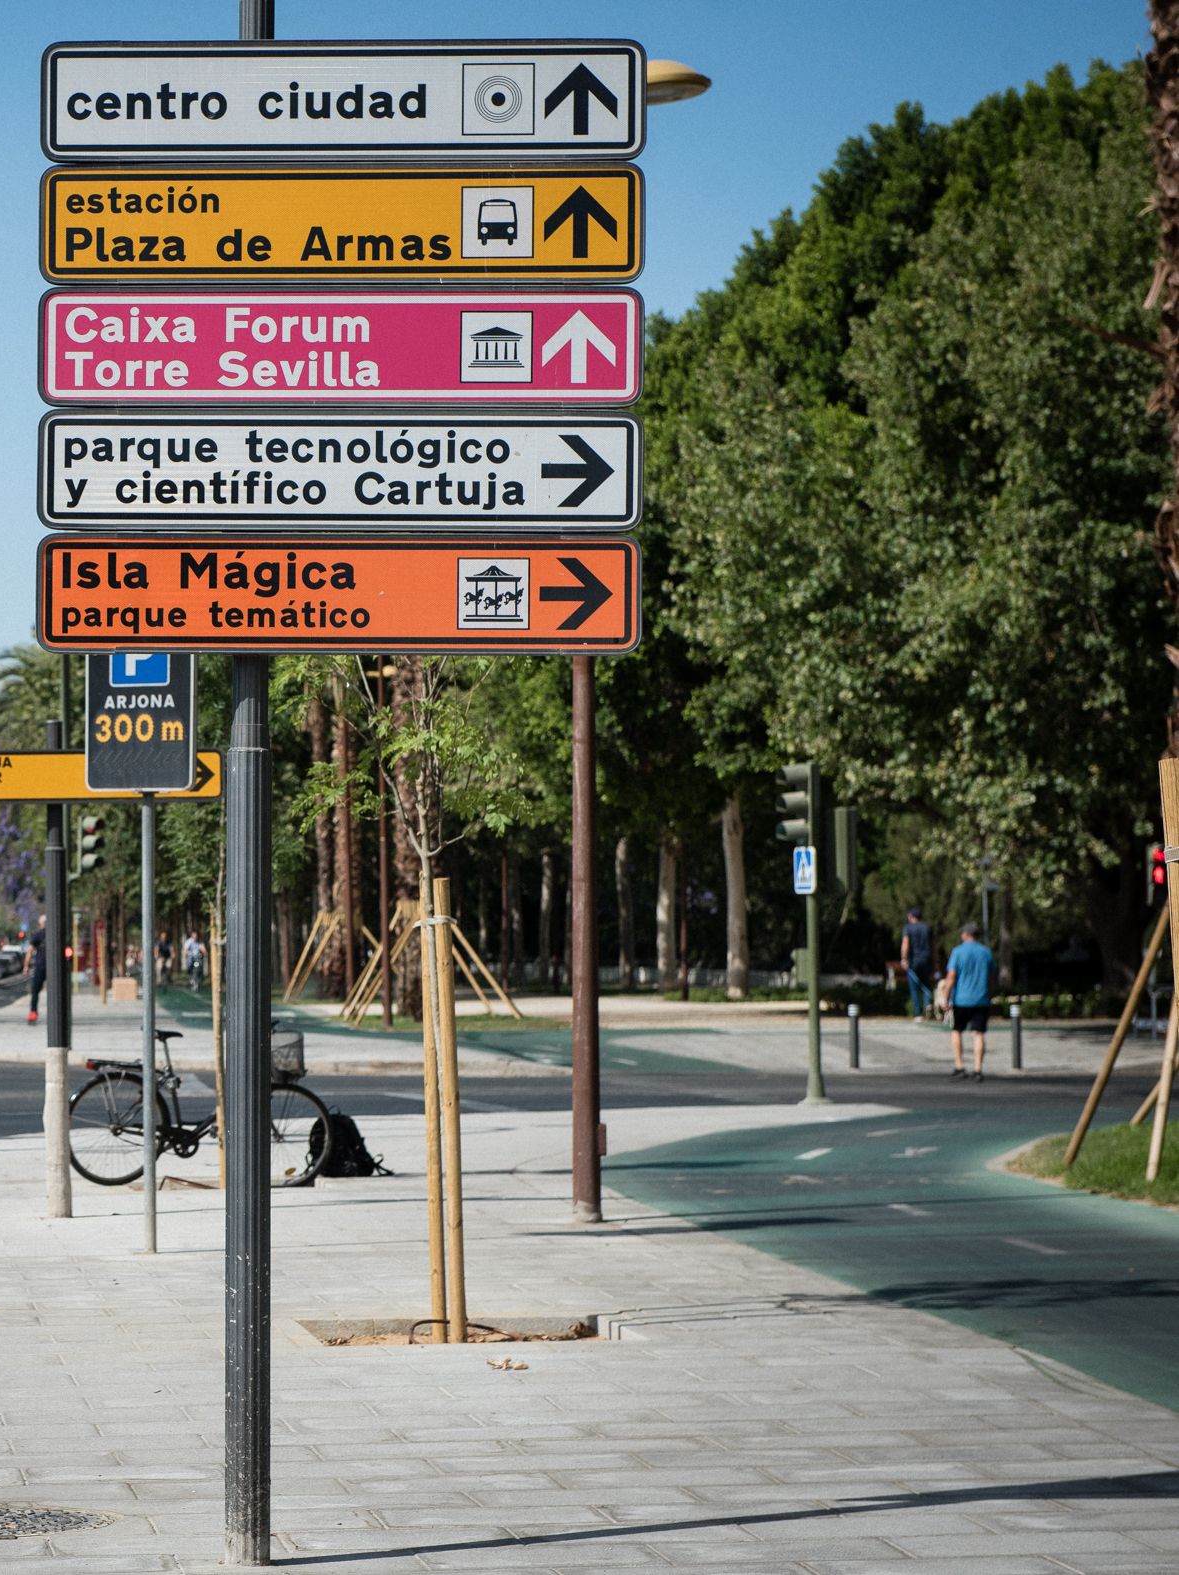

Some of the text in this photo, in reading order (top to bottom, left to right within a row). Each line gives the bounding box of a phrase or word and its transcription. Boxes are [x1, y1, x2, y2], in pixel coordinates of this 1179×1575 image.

[66, 82, 427, 120] centro ciudad
[66, 186, 220, 214] estación
[66, 226, 452, 262] Plaza de Armas
[65, 307, 370, 344] Caixa Forum
[65, 351, 381, 388] Torre Sevilla
[64, 430, 511, 468] parque tecnológico
[65, 470, 526, 511] y científico Cartuja
[61, 551, 357, 598] Isla Mágica
[61, 601, 371, 635] parque temático
[104, 693, 175, 710] ARJONA
[95, 713, 184, 743] 300 m
